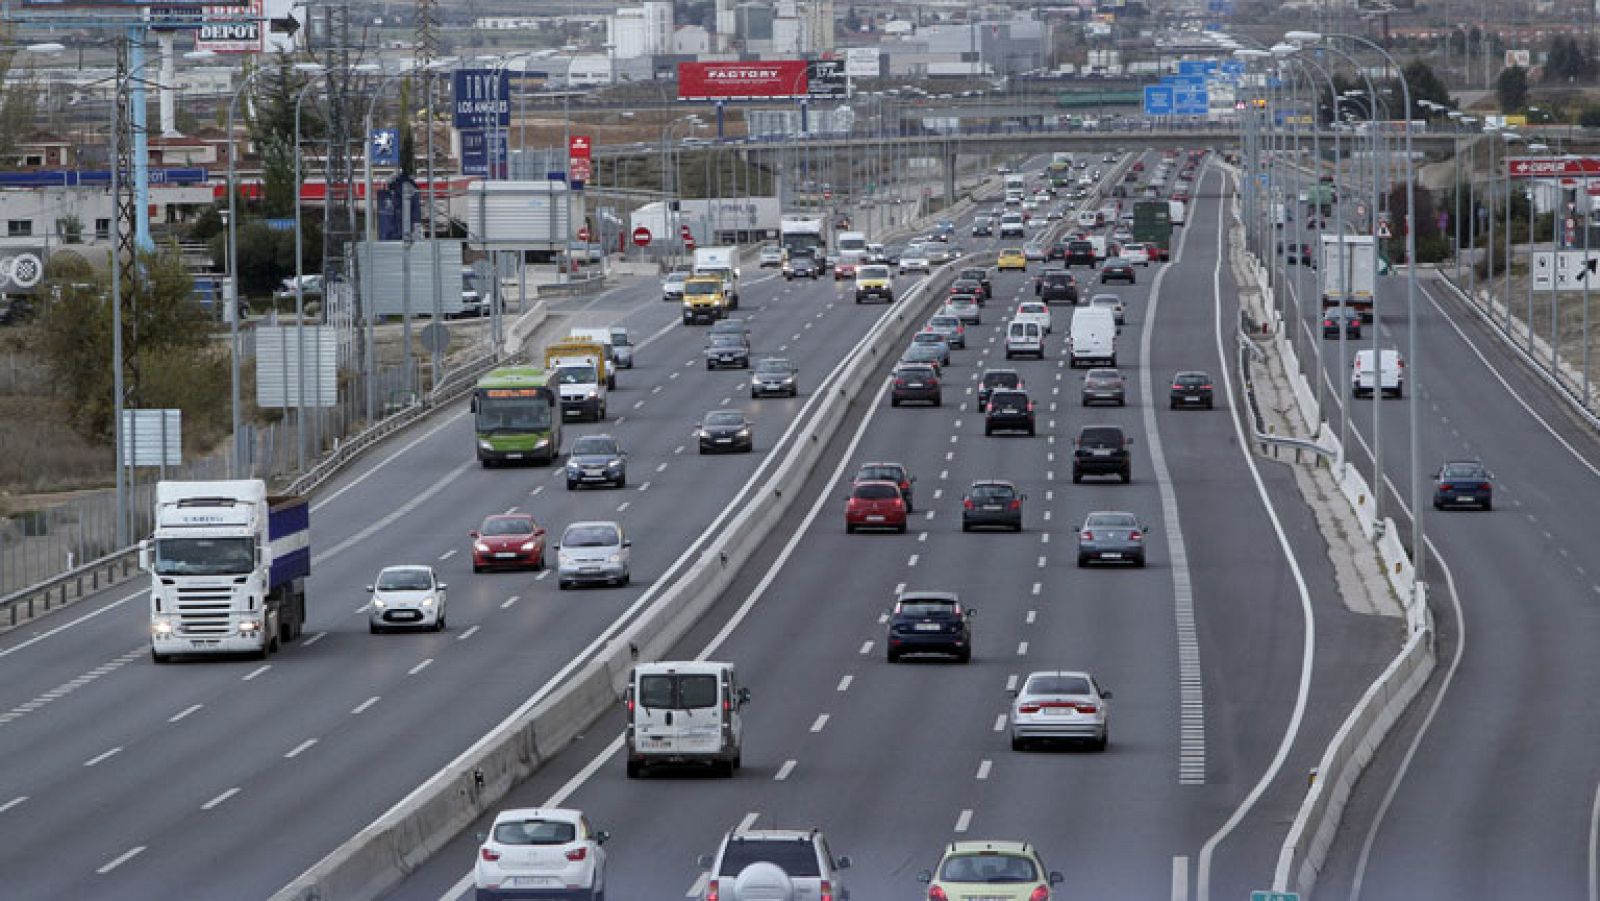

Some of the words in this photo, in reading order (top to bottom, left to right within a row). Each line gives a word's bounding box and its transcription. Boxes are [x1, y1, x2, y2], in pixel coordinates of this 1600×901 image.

[201, 24, 257, 38] DEPOT
[708, 70, 778, 78] FACTORY
[457, 101, 472, 113] LOS
